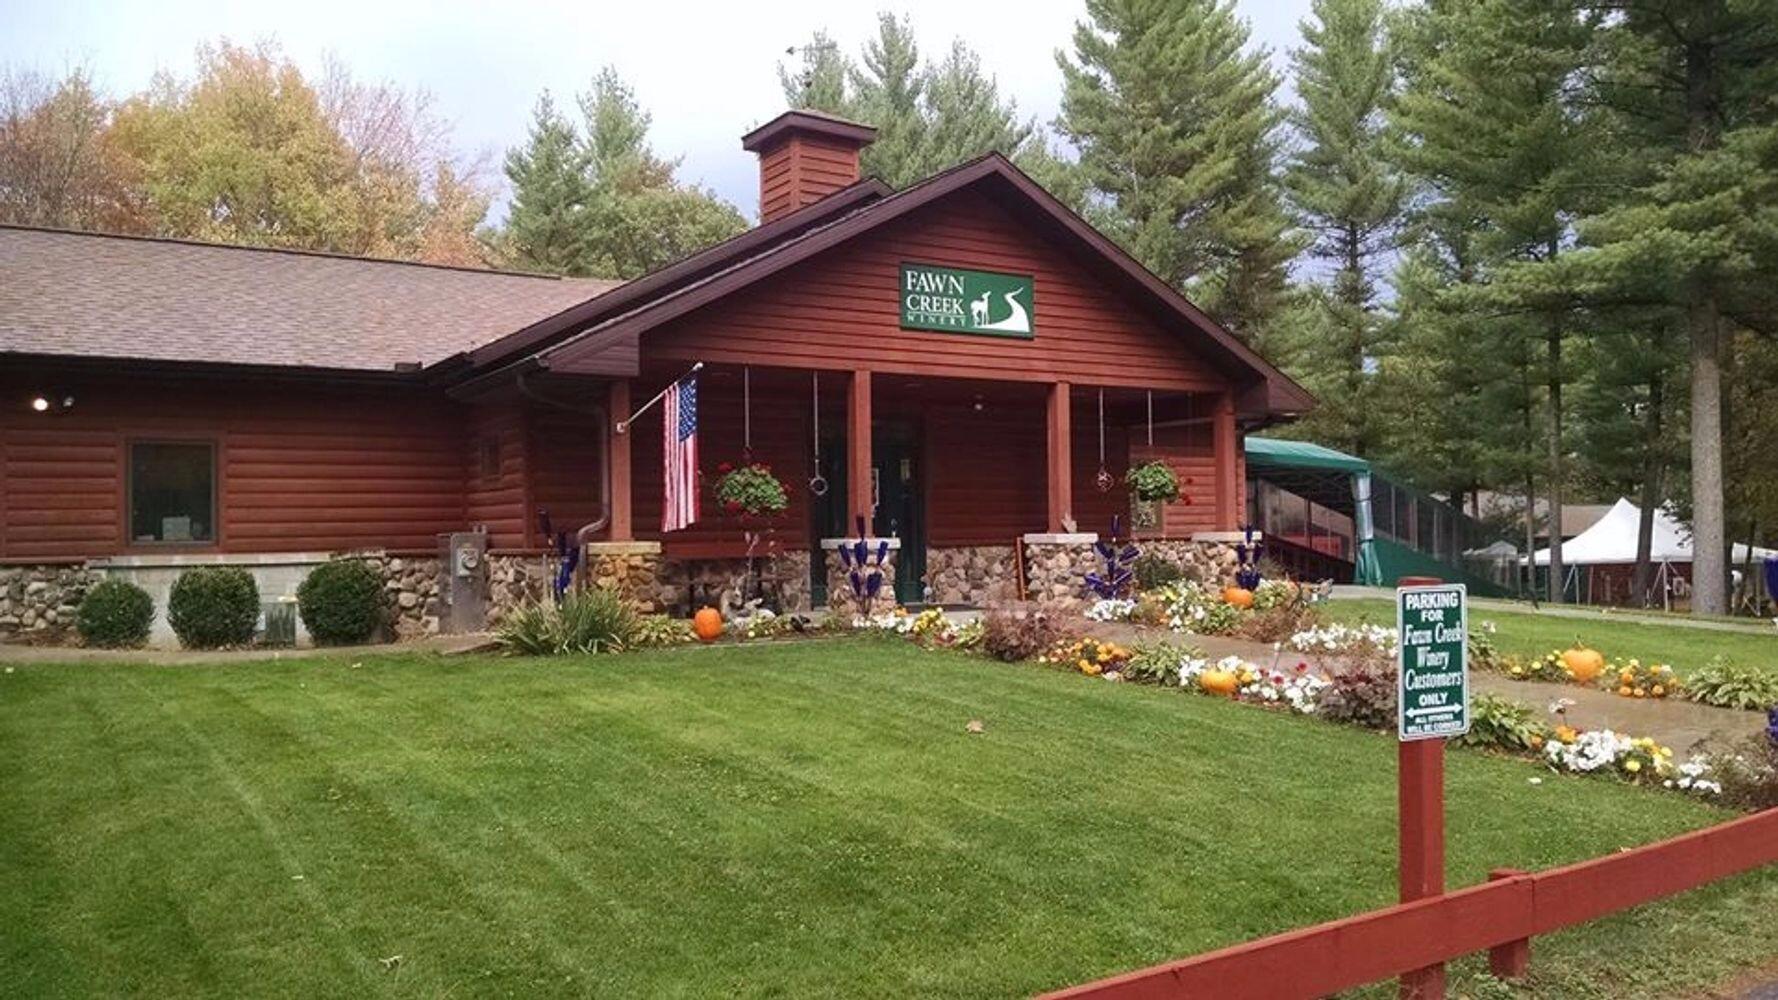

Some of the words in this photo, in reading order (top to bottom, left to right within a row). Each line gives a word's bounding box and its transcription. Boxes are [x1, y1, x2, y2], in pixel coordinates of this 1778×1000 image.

[906, 270, 964, 294] FAWN
[906, 294, 964, 314] CREEK
[907, 314, 966, 327] WINERY
[1405, 592, 1459, 610] PARKING
[1421, 609, 1444, 622] FOR
[1404, 624, 1433, 645] Fawn
[1435, 621, 1463, 644] Creek
[1417, 646, 1450, 670] Winery
[1405, 669, 1463, 690] Customers
[1419, 692, 1448, 706] ONLY
